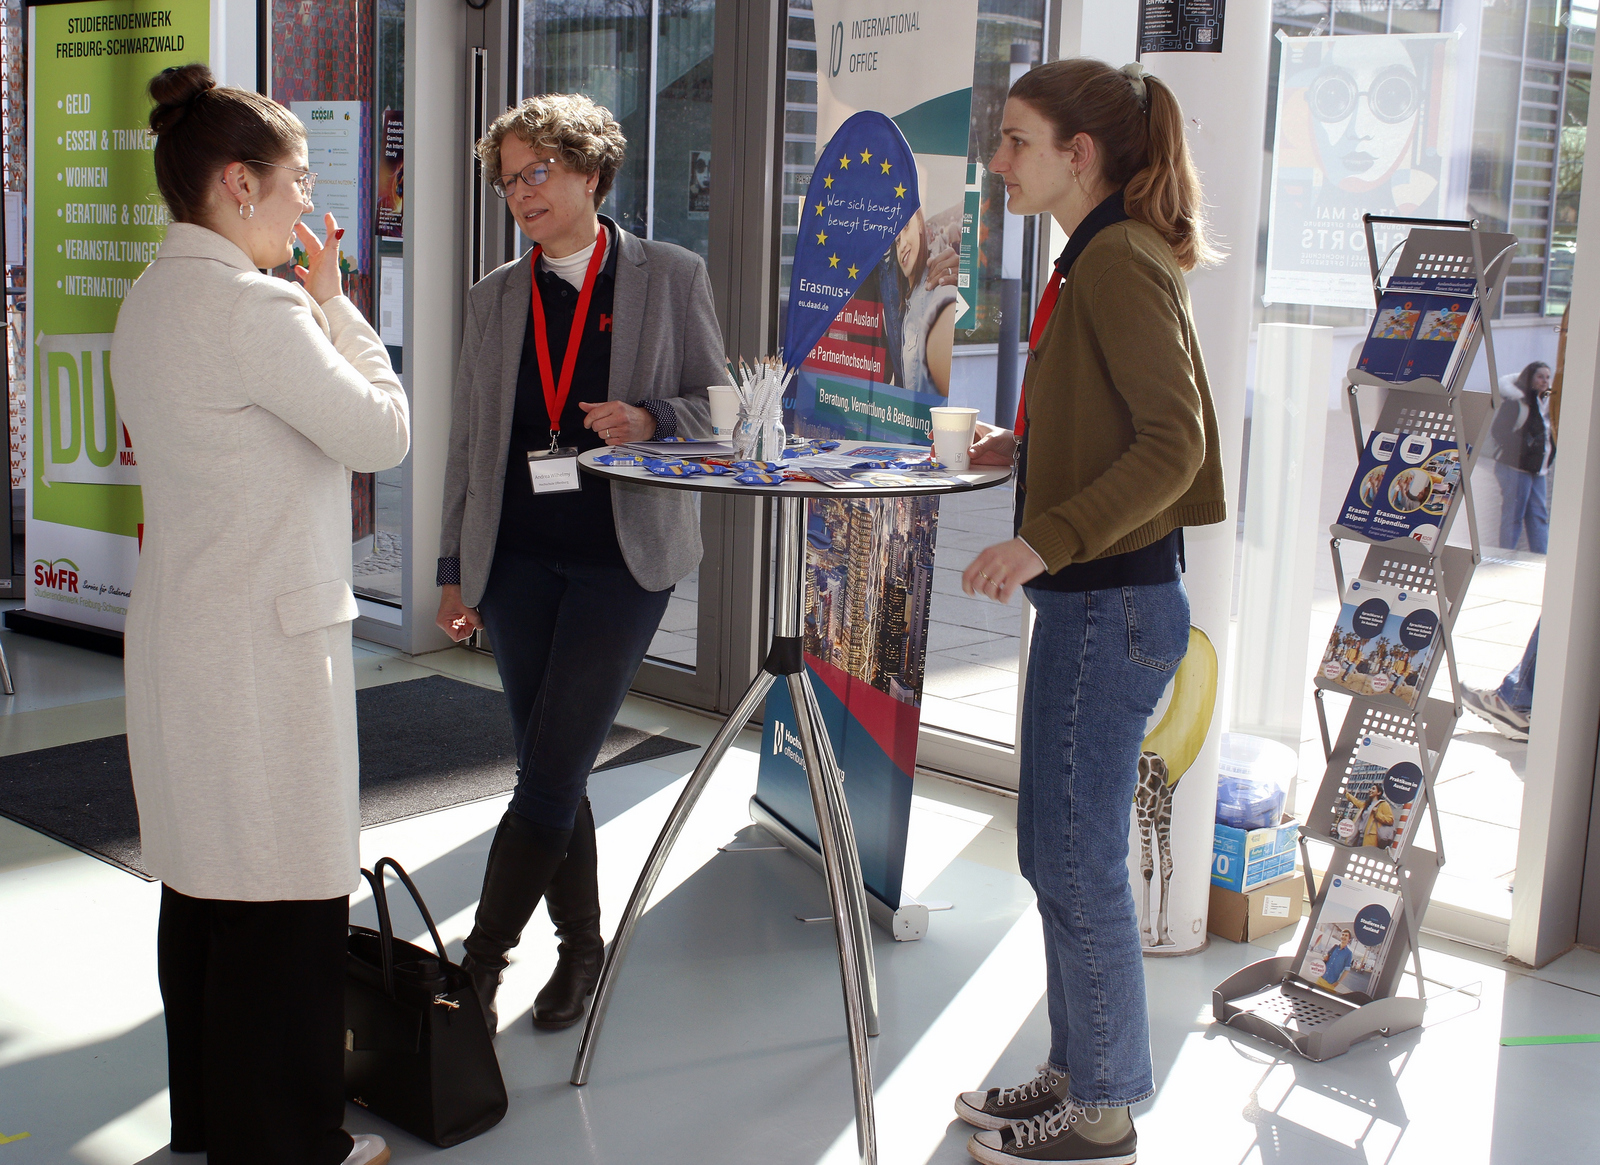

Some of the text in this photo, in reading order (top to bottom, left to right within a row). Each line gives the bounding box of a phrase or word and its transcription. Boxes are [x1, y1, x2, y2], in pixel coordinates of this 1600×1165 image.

[68, 10, 172, 34] STUDIERENDENWERK
[851, 11, 920, 40] INTERNATIONAL
[56, 35, 185, 59] FREIBURG-SCHWARZWALD
[850, 52, 878, 73] OFFICE
[66, 93, 91, 114] GELD
[311, 110, 334, 120] ECOSIA
[66, 130, 96, 151] ESSEN
[101, 130, 109, 150] &
[65, 167, 108, 188] WOHNEN
[65, 203, 116, 224] BERATUNG
[121, 204, 129, 225] &
[827, 194, 903, 220] Wer sich bewegt,
[828, 214, 898, 239] bewegt Europa!
[800, 278, 850, 298] Erasmus+
[798, 300, 830, 312] eu.daad.de
[844, 308, 852, 324] im
[853, 310, 880, 328] Ausland
[818, 346, 881, 373] Partnerhochschulen
[47, 350, 118, 468] DU
[820, 388, 850, 412] Beratung,
[851, 396, 886, 423] Vermittlung
[886, 405, 892, 422] &
[892, 407, 930, 434] Betreuung
[1372, 516, 1410, 530] Stipendium
[34, 560, 79, 594] SWFR
[82, 580, 99, 592] Service
[99, 583, 107, 595] für
[34, 587, 79, 605] Studierendenwerk
[1393, 783, 1411, 792] Ausland
